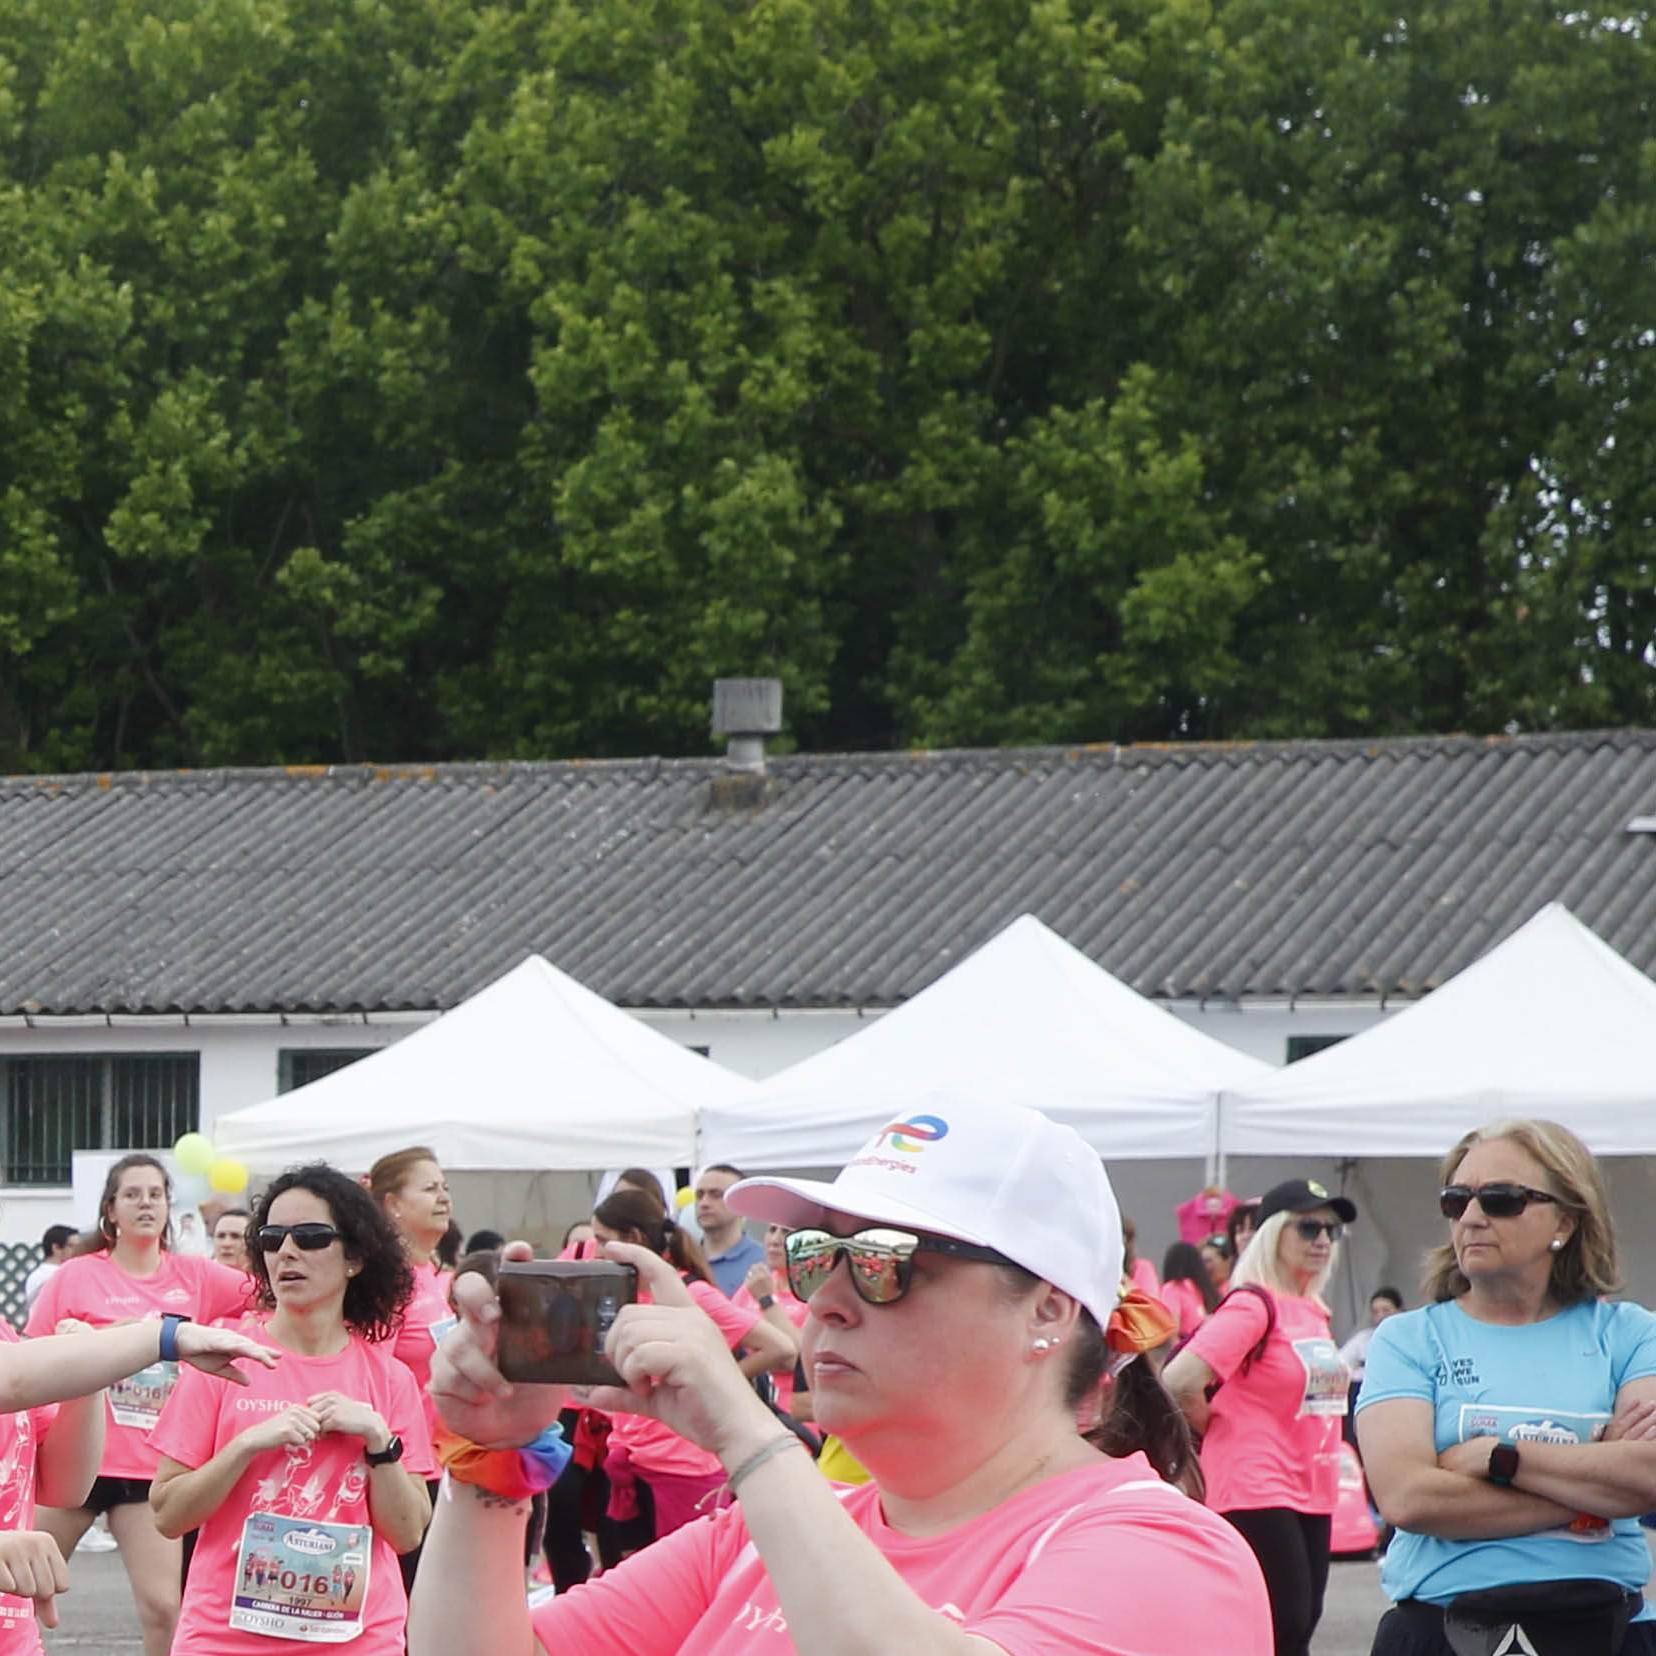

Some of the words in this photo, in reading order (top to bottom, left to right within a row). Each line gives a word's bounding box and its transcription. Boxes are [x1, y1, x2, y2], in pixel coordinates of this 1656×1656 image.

[1453, 1358, 1474, 1368] YES
[1455, 1367, 1472, 1378] WE
[280, 1570, 329, 1595] 016
